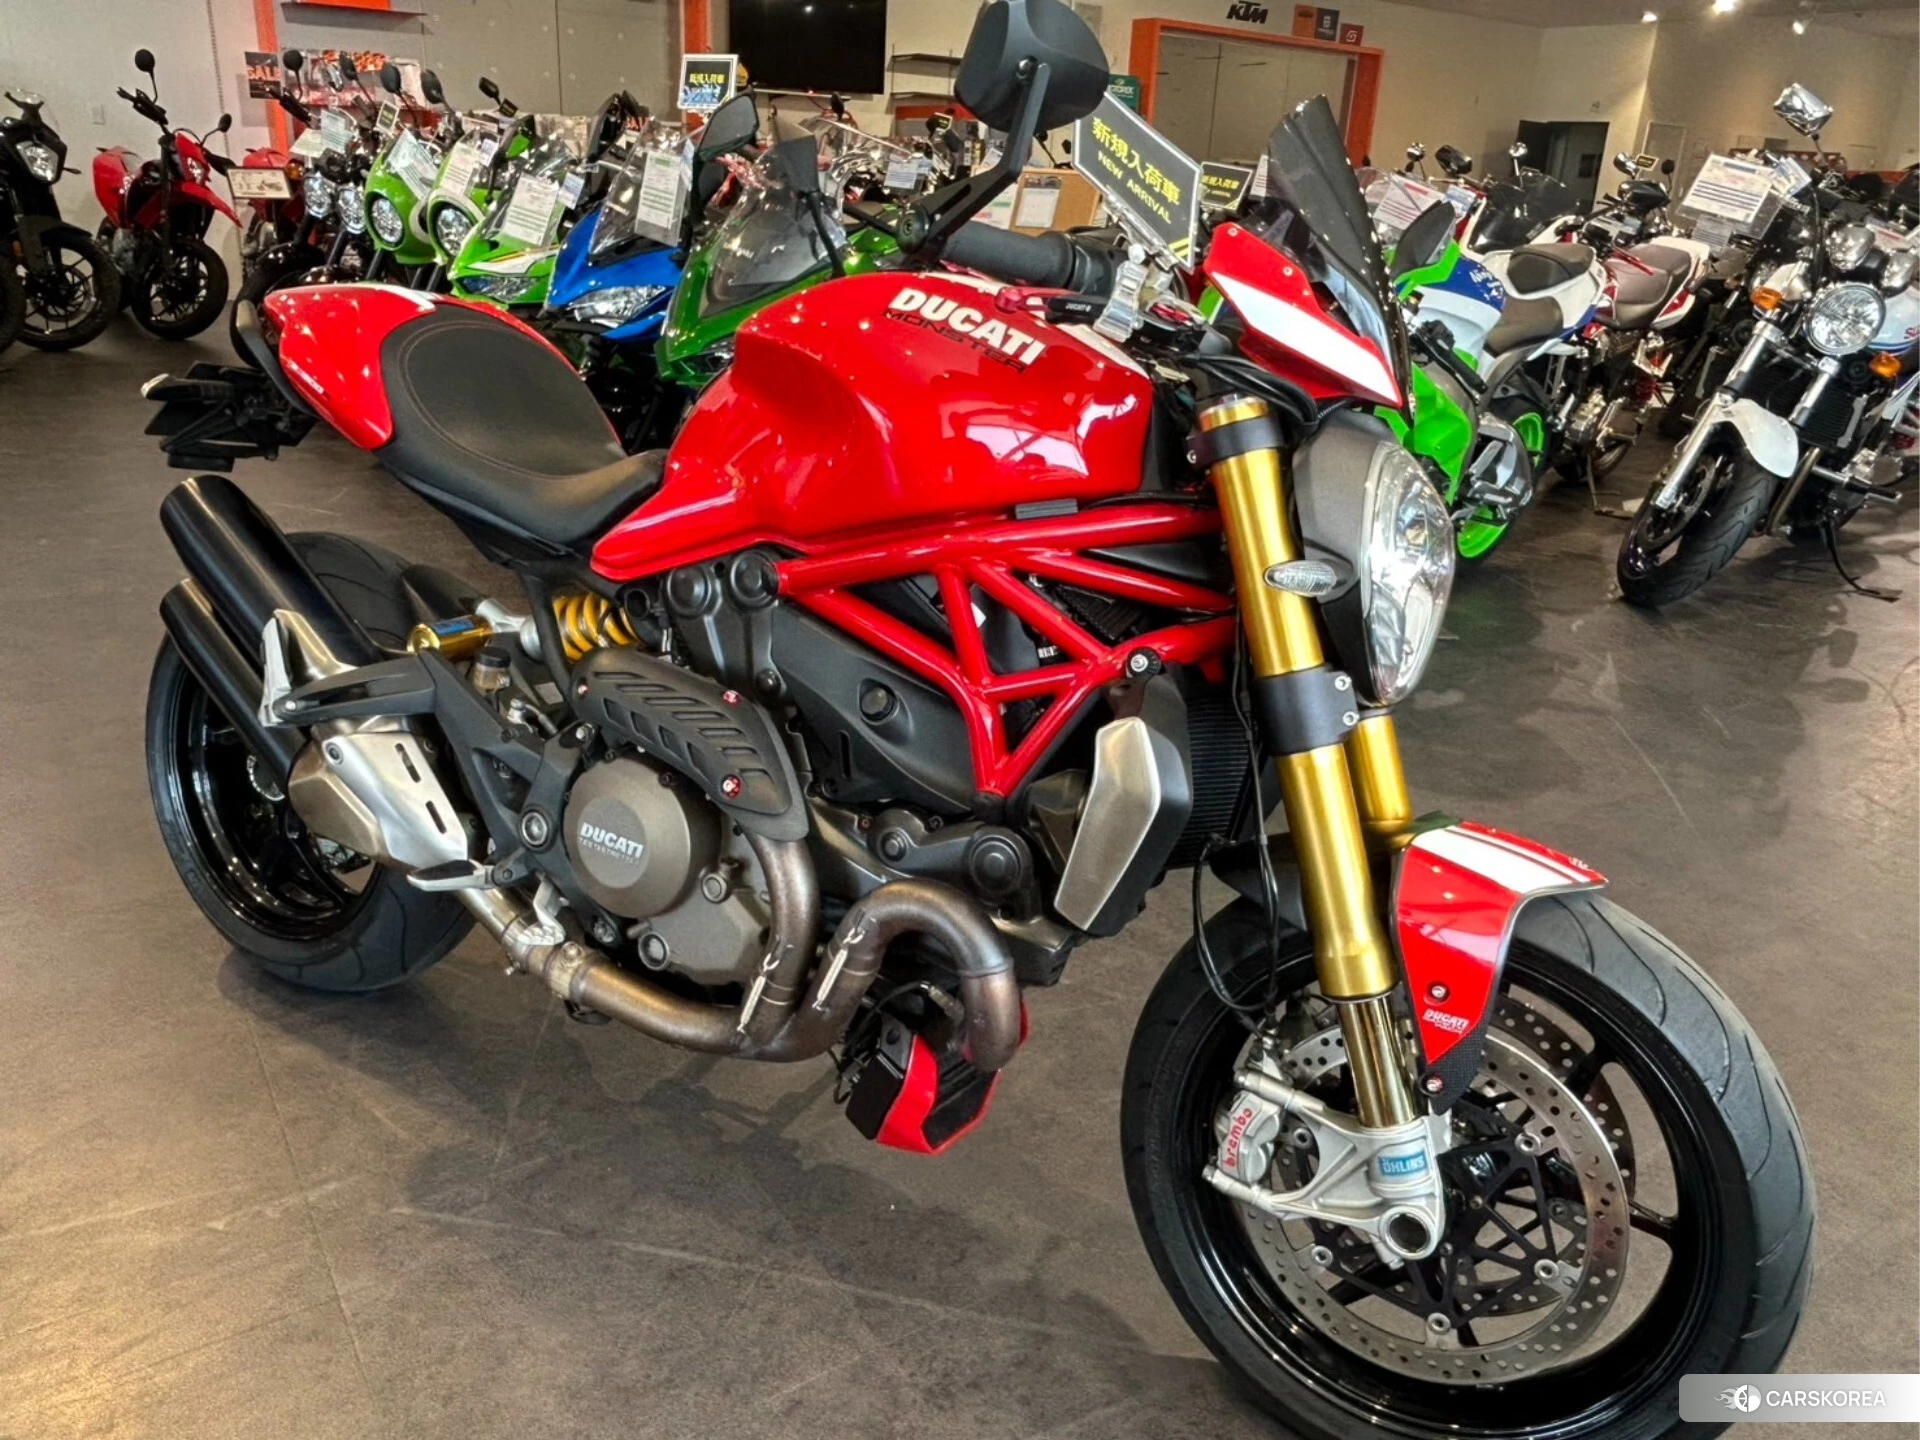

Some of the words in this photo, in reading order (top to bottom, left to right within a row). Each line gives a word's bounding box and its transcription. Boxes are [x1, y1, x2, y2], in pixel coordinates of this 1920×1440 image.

[1226, 1, 1269, 24] KTM
[1092, 116, 1180, 205] 新規入荷車
[1098, 150, 1124, 180] NEW
[1126, 178, 1172, 224] ARRIVAL
[883, 308, 1026, 374] MONSTER
[888, 287, 1046, 366] DUCATI
[580, 822, 644, 859] DUCATI
[1422, 1008, 1470, 1031] DUCATI
[1224, 1107, 1253, 1168] brembo
